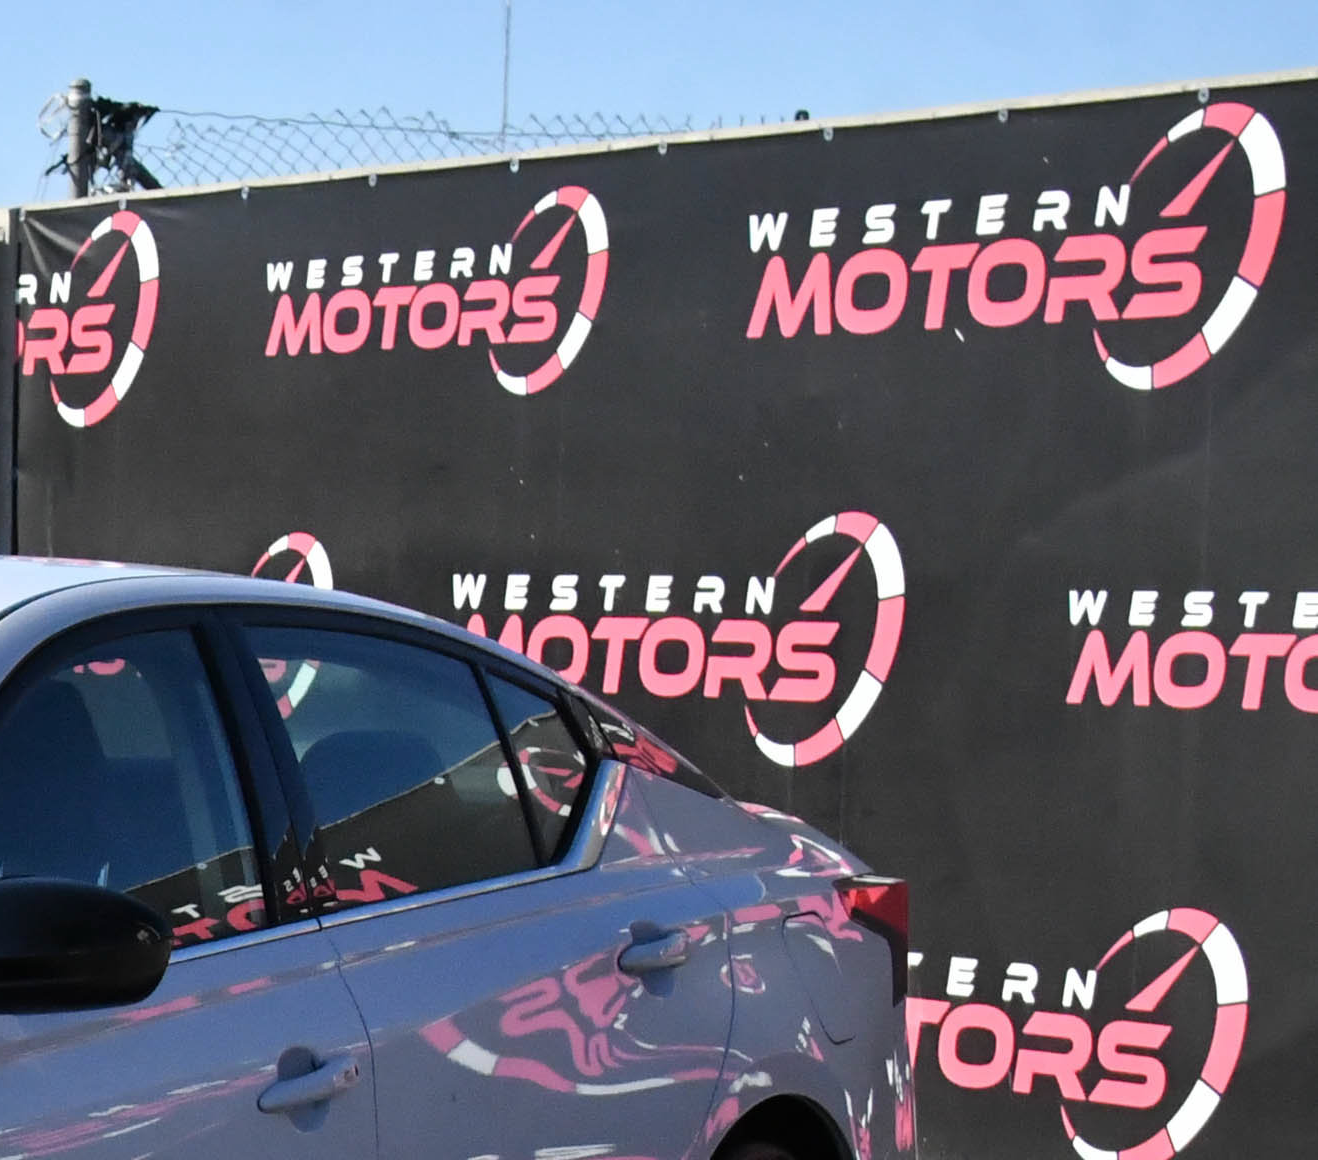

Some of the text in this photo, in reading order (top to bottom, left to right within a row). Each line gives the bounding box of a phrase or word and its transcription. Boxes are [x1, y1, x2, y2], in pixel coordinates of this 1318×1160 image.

[748, 183, 1132, 254] WESTERN
[266, 242, 514, 294] WESTERN
[746, 225, 1208, 340] MOTORS
[265, 278, 561, 358] MOTORS
[452, 572, 776, 616] WESTERN
